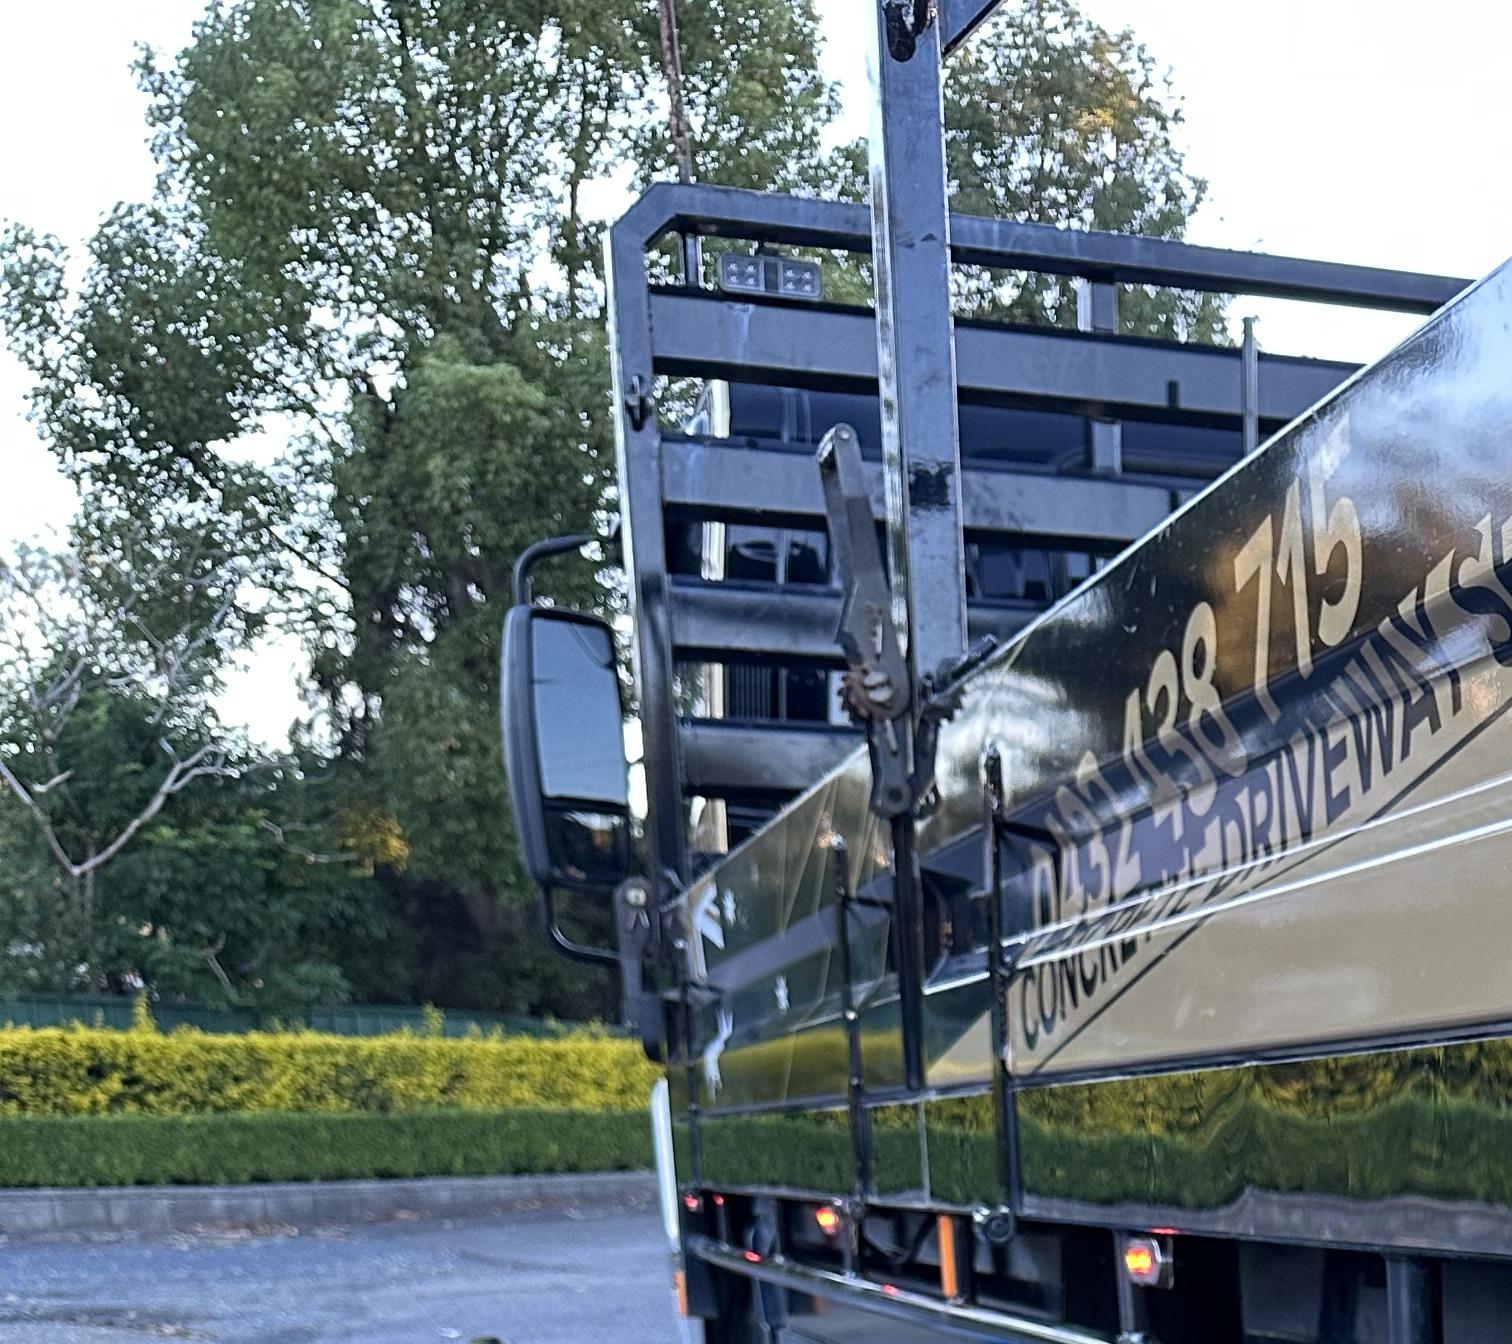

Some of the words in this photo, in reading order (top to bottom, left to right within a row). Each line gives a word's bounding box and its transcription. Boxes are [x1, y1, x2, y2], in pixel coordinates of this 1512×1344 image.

[1124, 601, 1247, 842] 438
[1233, 412, 1362, 723] 715
[1205, 578, 1461, 903] DRIVEWAY
